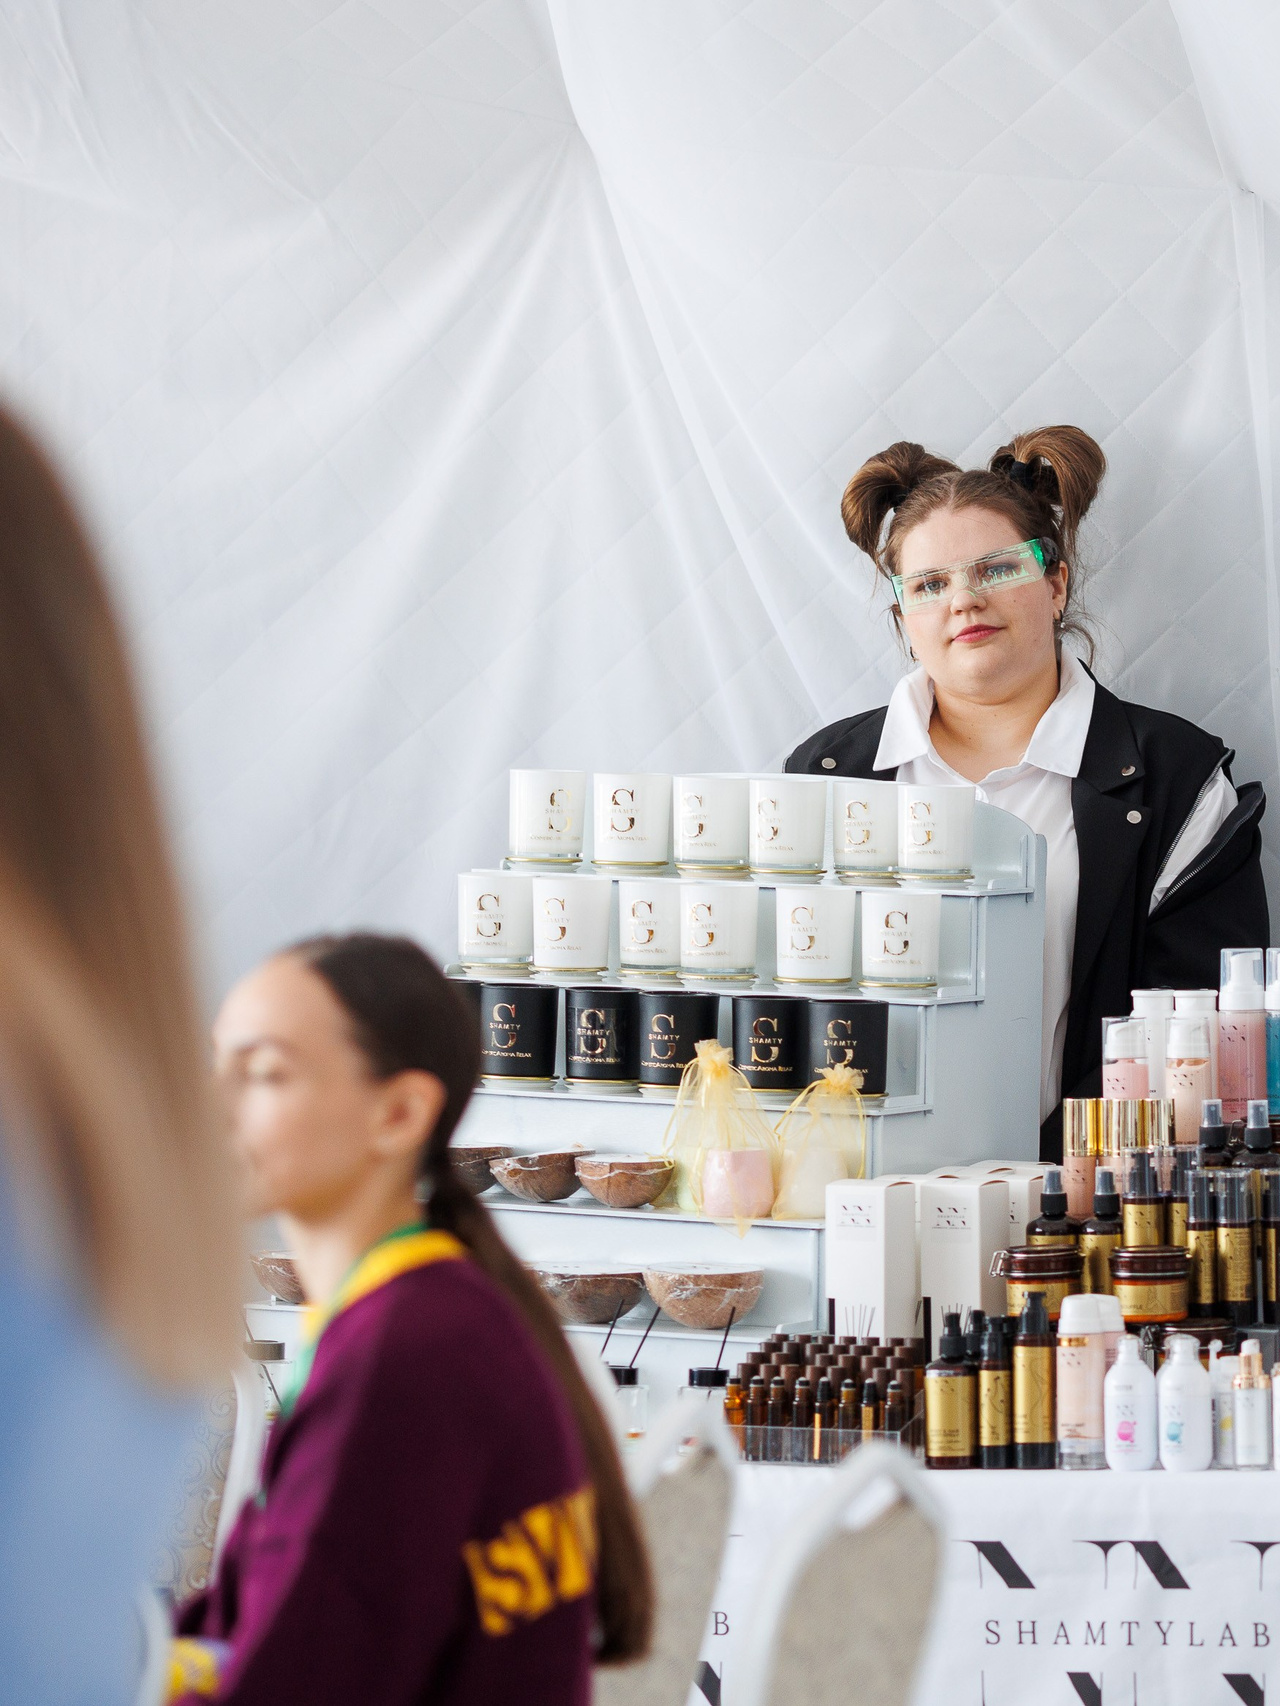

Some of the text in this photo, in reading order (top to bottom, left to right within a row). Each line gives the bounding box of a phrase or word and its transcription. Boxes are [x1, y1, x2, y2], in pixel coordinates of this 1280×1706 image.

[489, 1022, 521, 1030] SHAMTY
[648, 1033, 680, 1041] SHAMTY
[748, 1036, 783, 1045] SHAMTY
[823, 1039, 857, 1047] SHAMTY
[984, 1619, 1272, 1649] SHAMTYLAB
